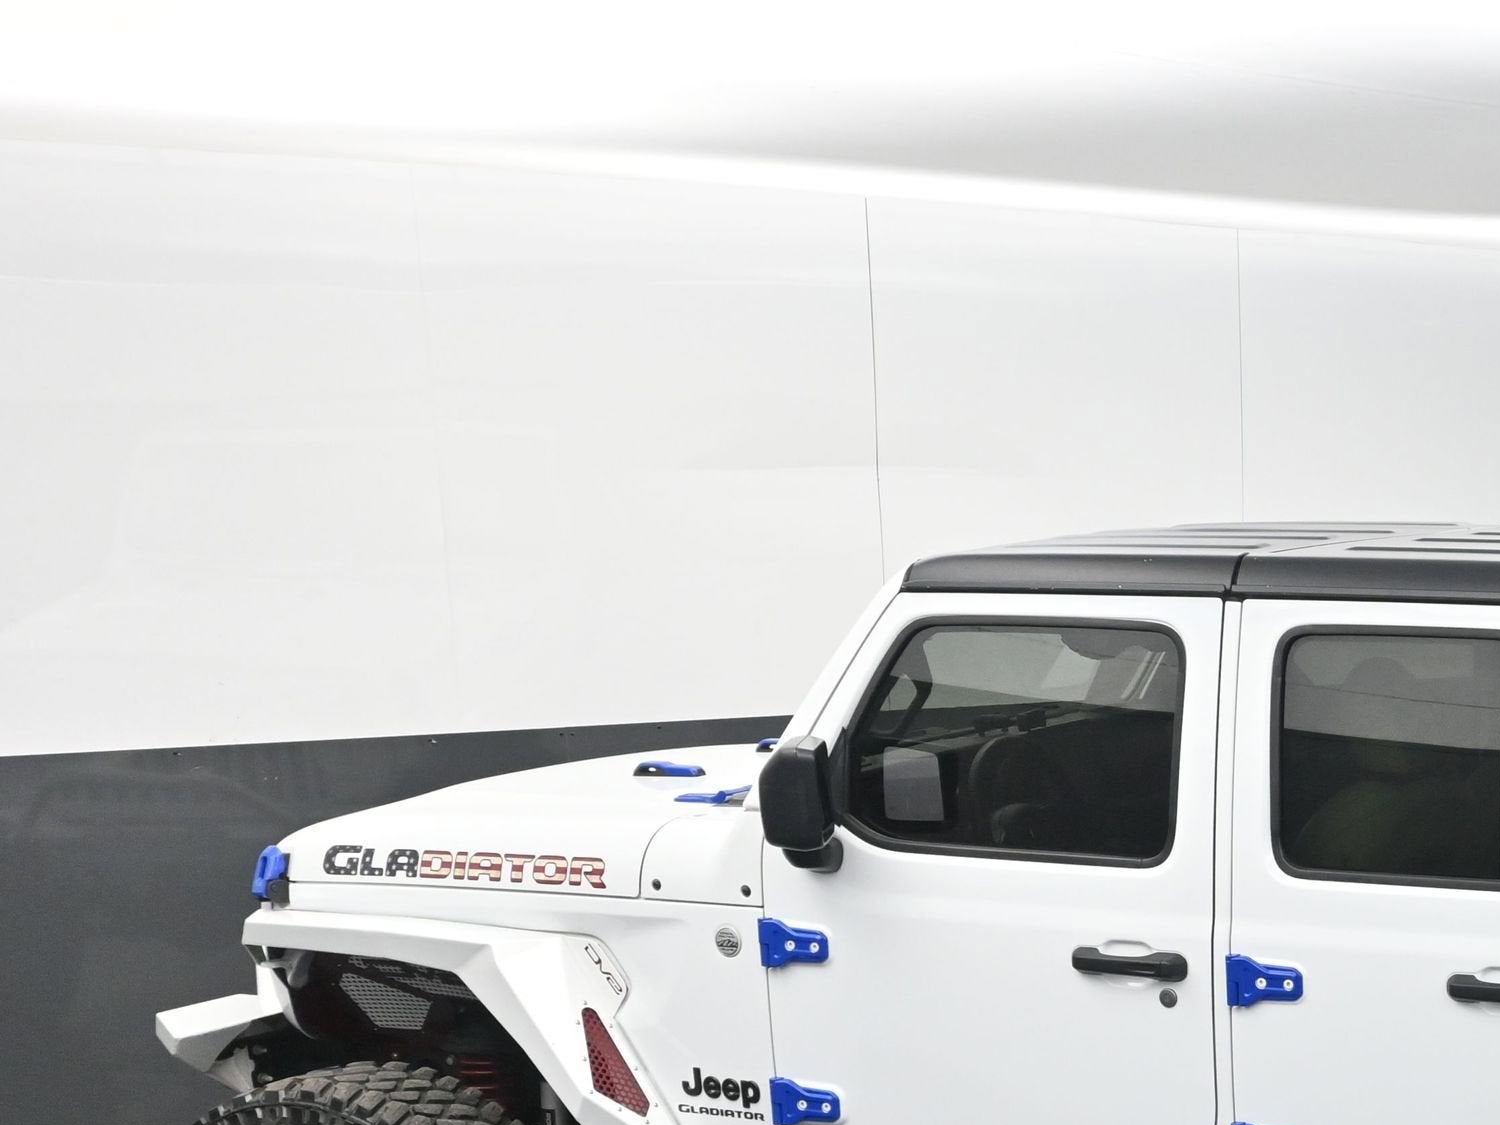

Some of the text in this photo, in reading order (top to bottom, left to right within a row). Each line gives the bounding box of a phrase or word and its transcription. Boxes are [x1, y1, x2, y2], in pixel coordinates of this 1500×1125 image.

[322, 844, 607, 889] GLADIATOR
[681, 1066, 761, 1109] Jeep
[678, 1103, 765, 1122] GLADIATOR
